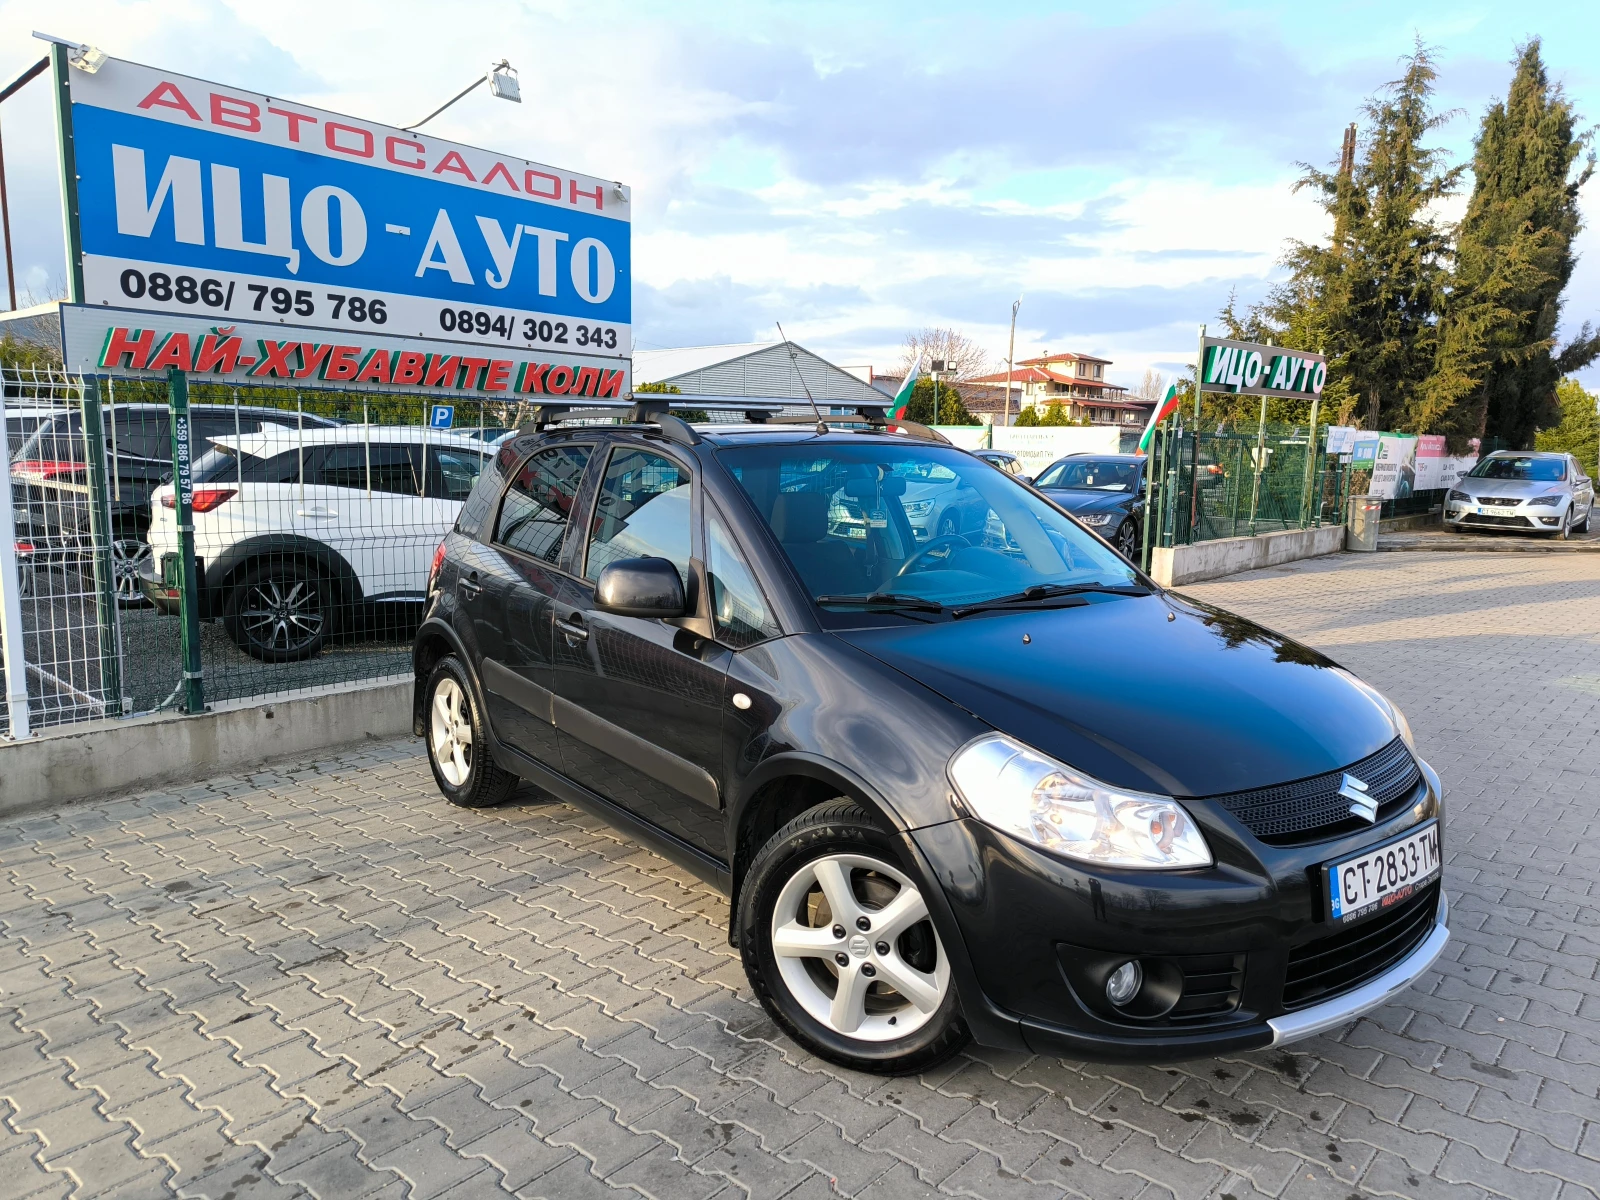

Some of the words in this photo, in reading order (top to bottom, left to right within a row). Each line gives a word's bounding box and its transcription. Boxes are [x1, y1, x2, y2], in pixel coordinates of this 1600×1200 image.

[136, 80, 603, 210] АВТОСАЛОН
[119, 268, 235, 311] 0886/
[247, 283, 315, 317] 795
[326, 293, 388, 325] 786
[439, 308, 515, 340] 0894/
[522, 318, 568, 344] 302
[575, 324, 618, 349] 343
[99, 325, 513, 392] НАЙ-ХУБАВИТЕ
[517, 361, 625, 398] КОЛИ
[1206, 345, 1327, 394] ИЦО-АУТО
[177, 417, 188, 441] +359
[177, 443, 189, 462] 886
[179, 463, 190, 476] 79
[180, 478, 191, 490] 57
[181, 492, 192, 505] 86
